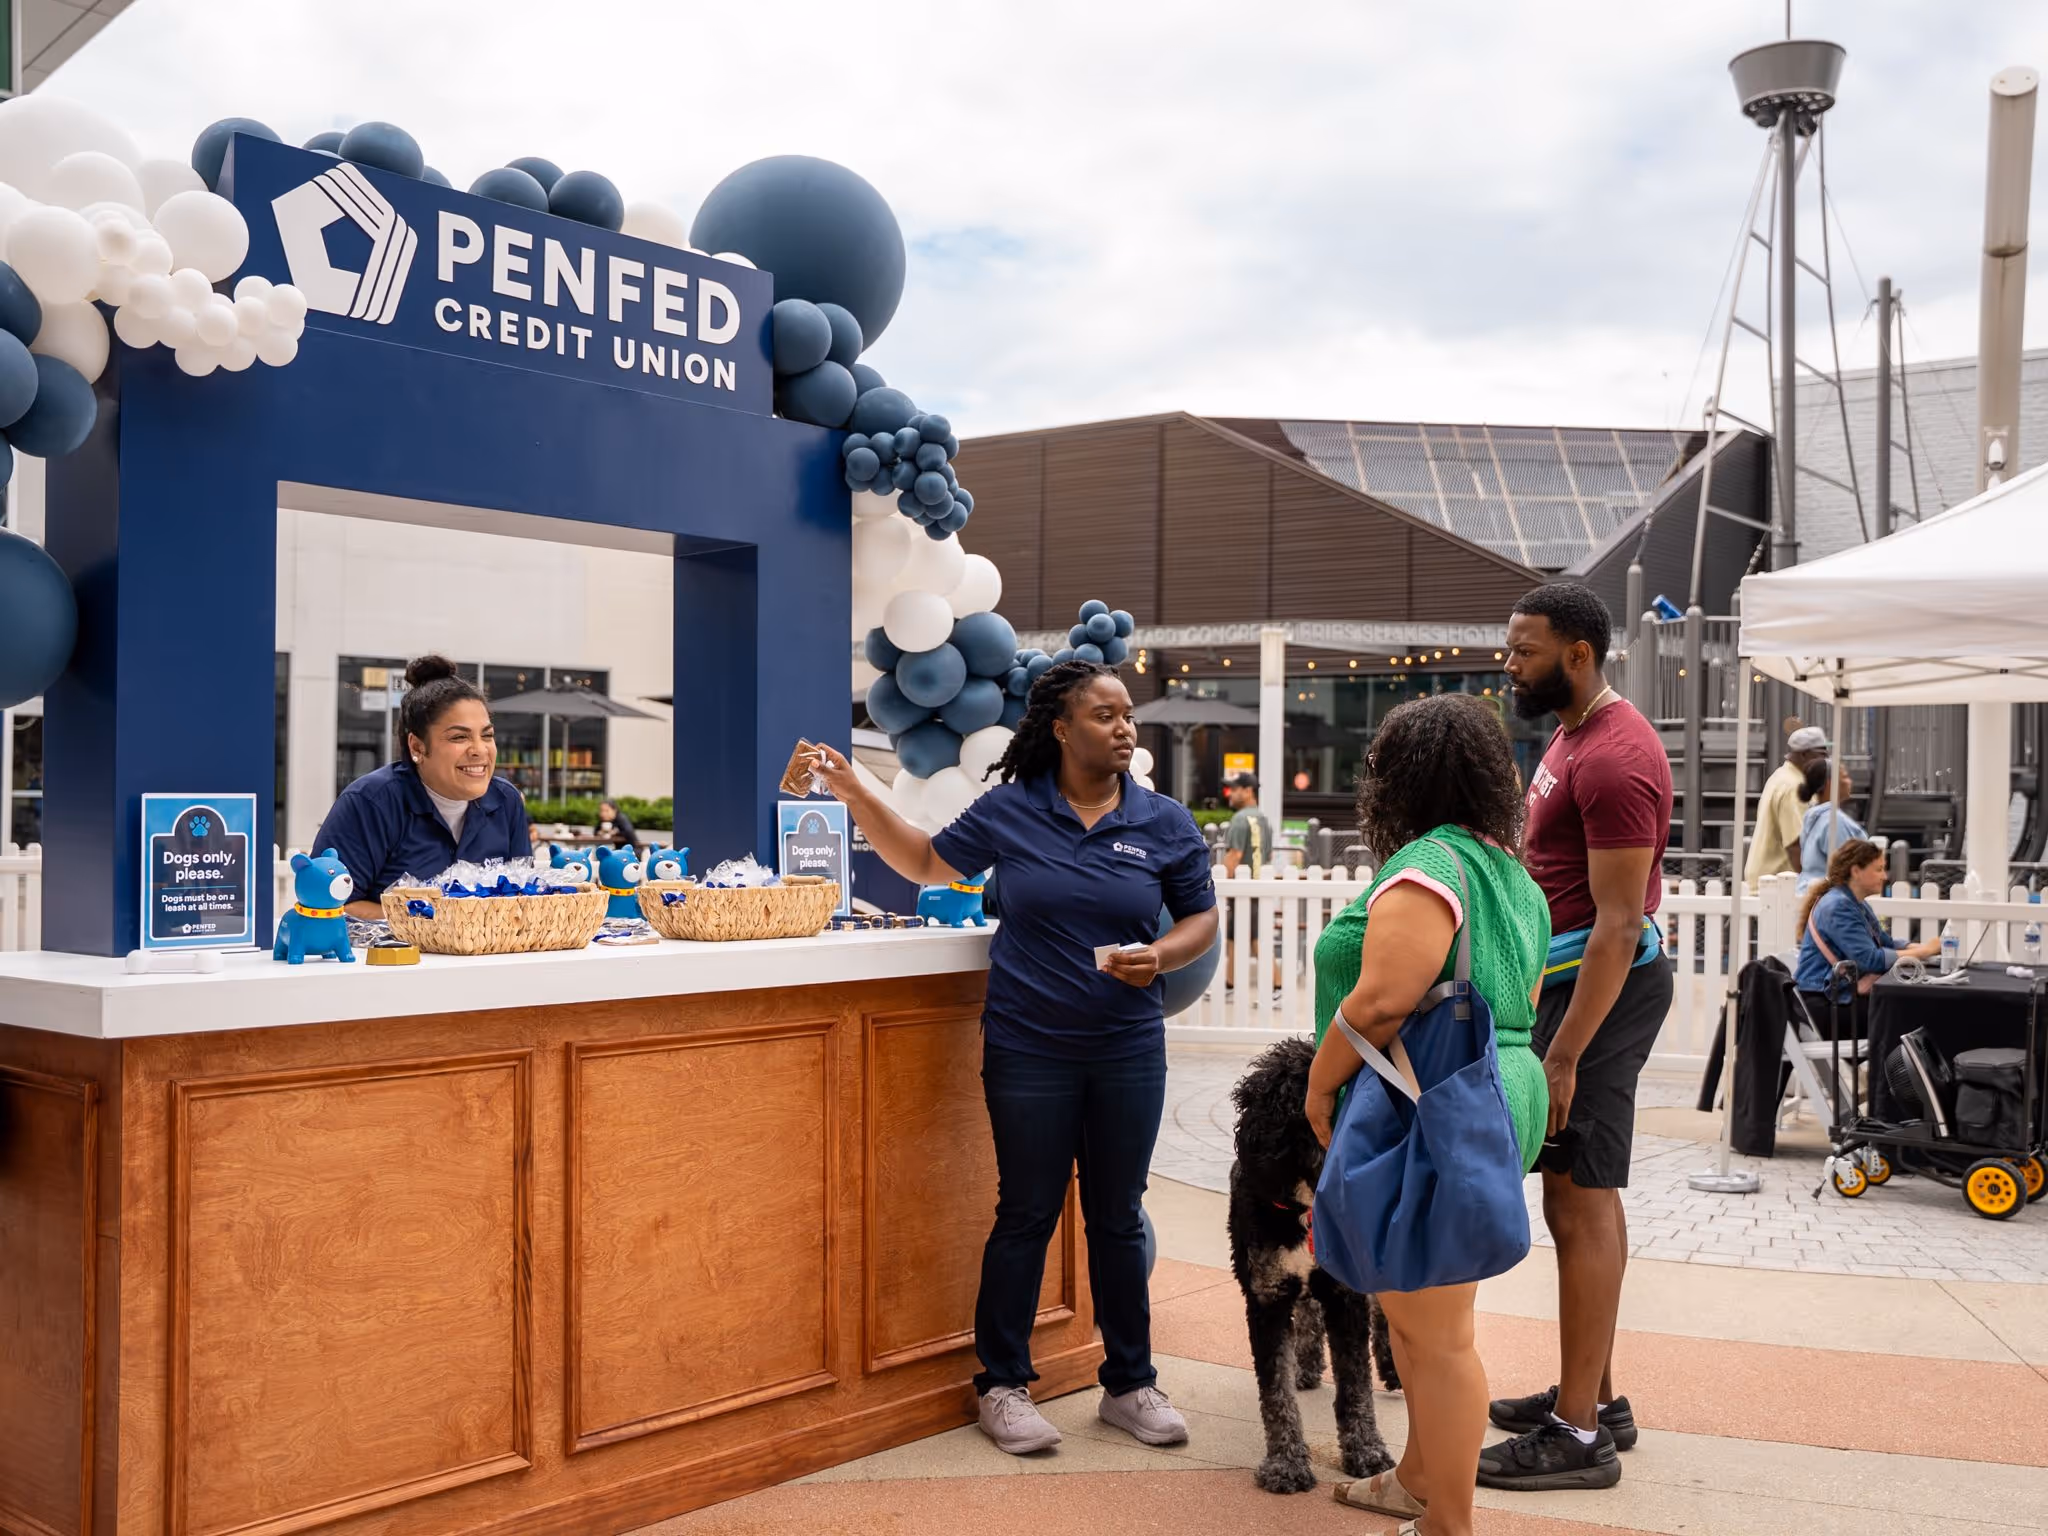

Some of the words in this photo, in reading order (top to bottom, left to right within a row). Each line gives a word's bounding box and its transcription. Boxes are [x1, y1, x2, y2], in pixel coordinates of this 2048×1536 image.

[437, 210, 741, 345] PENFED
[434, 297, 593, 360] CREDIT
[613, 335, 736, 392] UNION
[163, 851, 200, 867] Dogs
[202, 850, 236, 866] only,
[791, 845, 814, 858] Dogs
[815, 844, 836, 858] only,
[799, 858, 830, 870] please.
[175, 867, 224, 883] please.
[161, 894, 183, 904] Dogs
[184, 894, 205, 902] must
[206, 893, 217, 901] be
[165, 903, 187, 912] leash
[198, 902, 208, 910] all
[209, 902, 234, 910] times.
